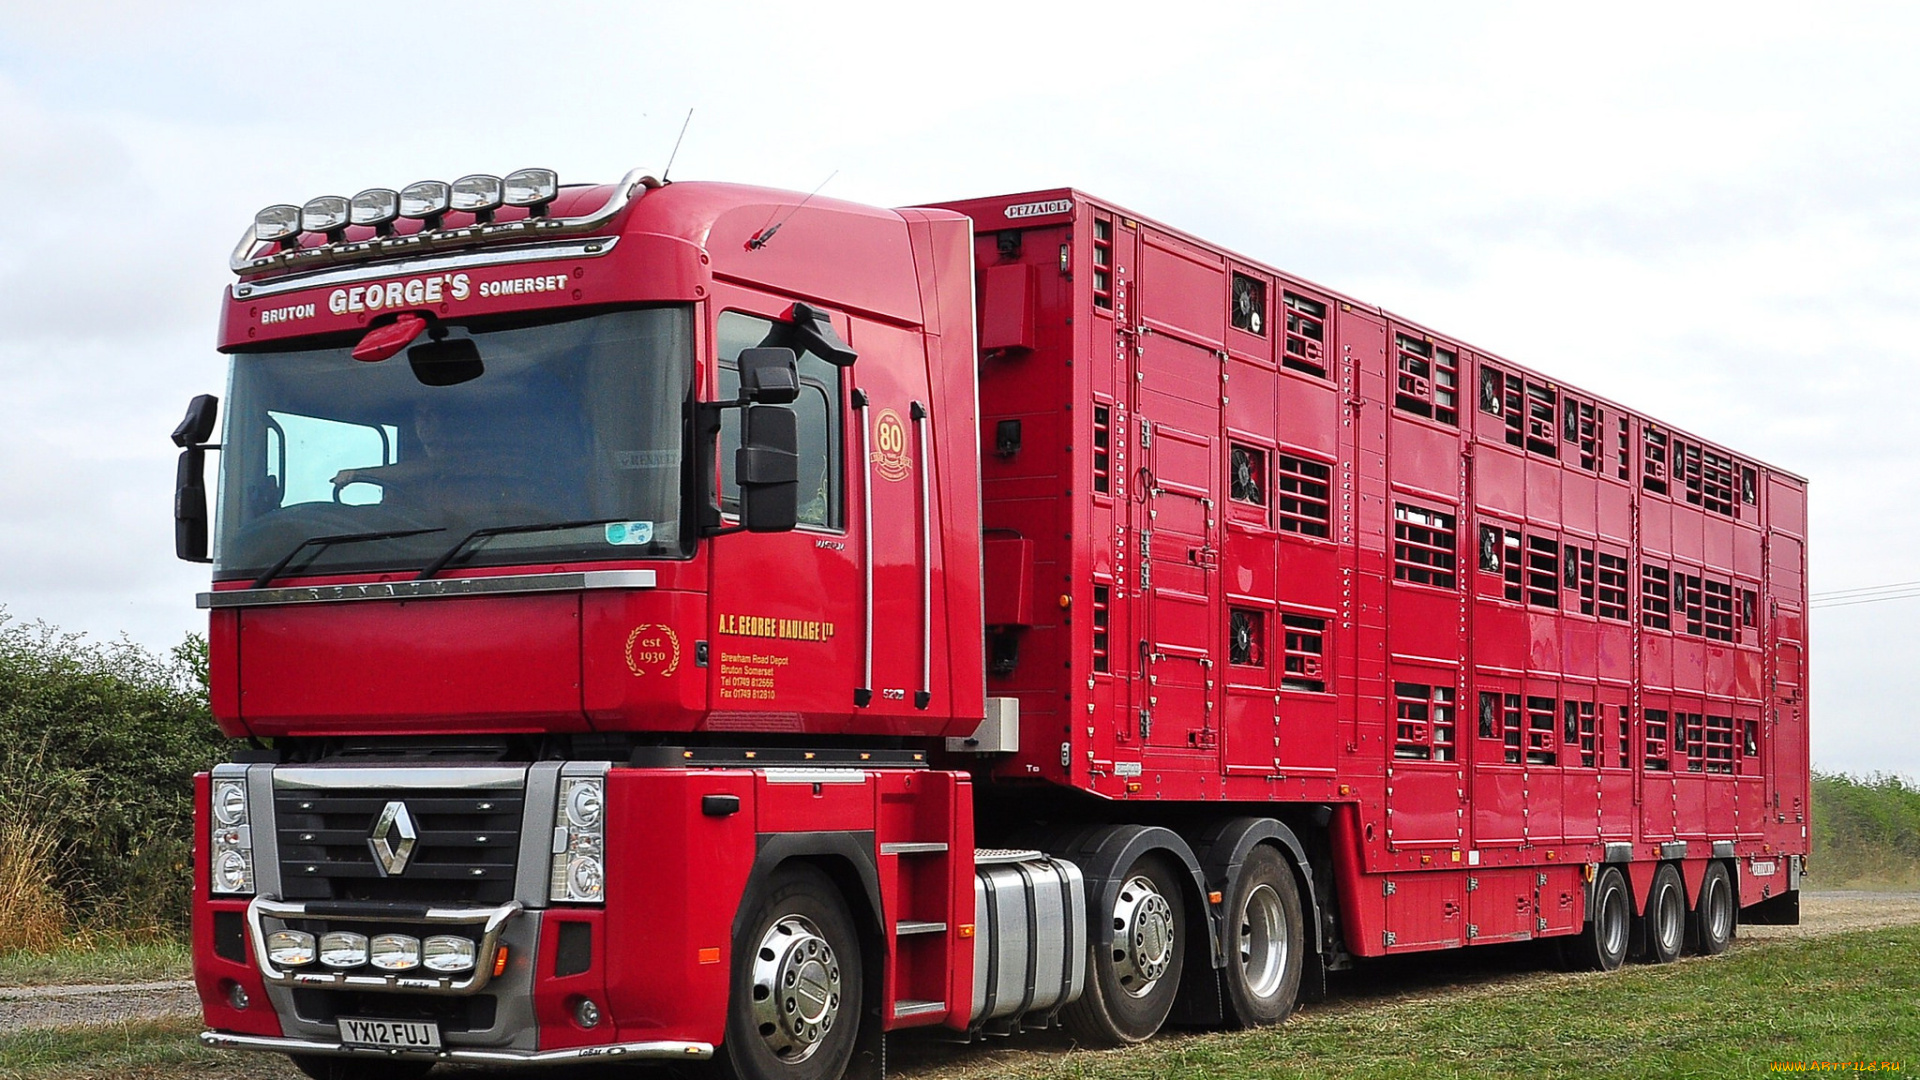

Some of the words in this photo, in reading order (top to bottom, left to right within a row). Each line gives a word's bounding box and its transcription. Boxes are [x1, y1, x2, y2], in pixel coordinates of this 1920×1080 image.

[261, 304, 315, 325] BRUTON
[328, 273, 471, 315] GEORGE'S
[479, 274, 568, 298] SOMERSET
[880, 422, 902, 453] 80
[739, 615, 777, 637] GEORGE
[779, 619, 820, 641] HAULAGE
[642, 638, 661, 647] est
[640, 651, 666, 664] 1930
[721, 652, 751, 663] Brewham
[752, 654, 769, 664] Road
[770, 655, 789, 667] Depot
[721, 664, 743, 675] Bruton
[744, 665, 774, 676] Somerset
[721, 676, 731, 686] Tel
[720, 688, 732, 698] Fax
[347, 1020, 389, 1043] YX12
[392, 1024, 431, 1046] FUJ
